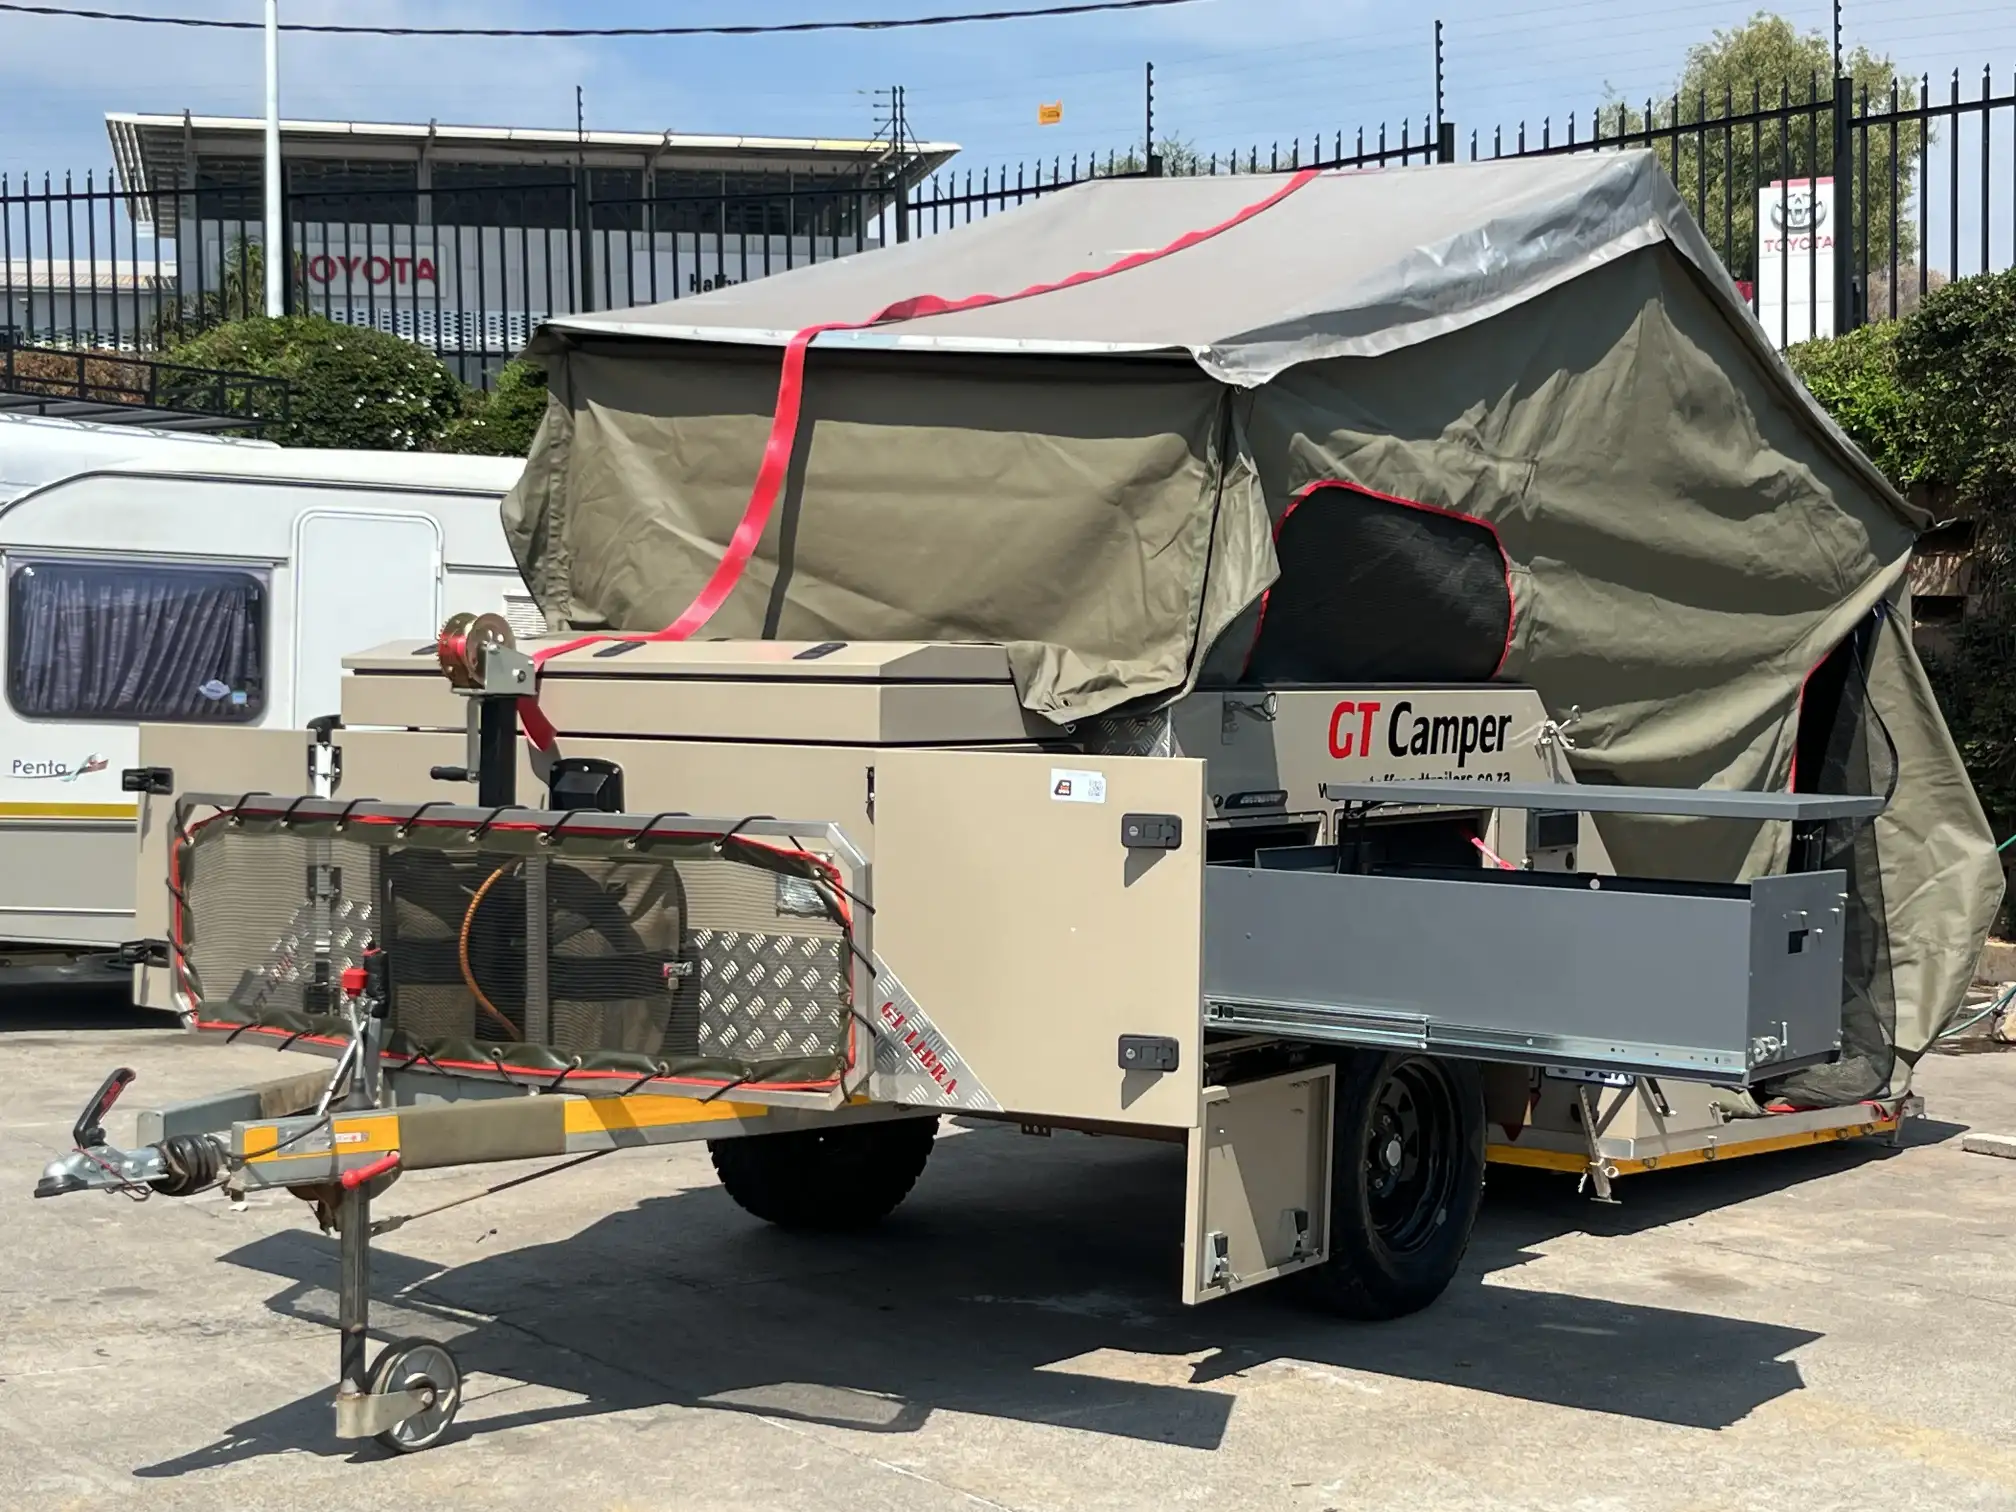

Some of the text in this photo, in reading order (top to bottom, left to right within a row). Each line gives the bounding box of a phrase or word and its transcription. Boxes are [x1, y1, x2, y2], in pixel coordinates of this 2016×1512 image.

[295, 254, 436, 284] OYOTA
[1328, 701, 1512, 768] GT Camper
[12, 759, 68, 775] Penta
[903, 1029, 958, 1096] LIBRA
